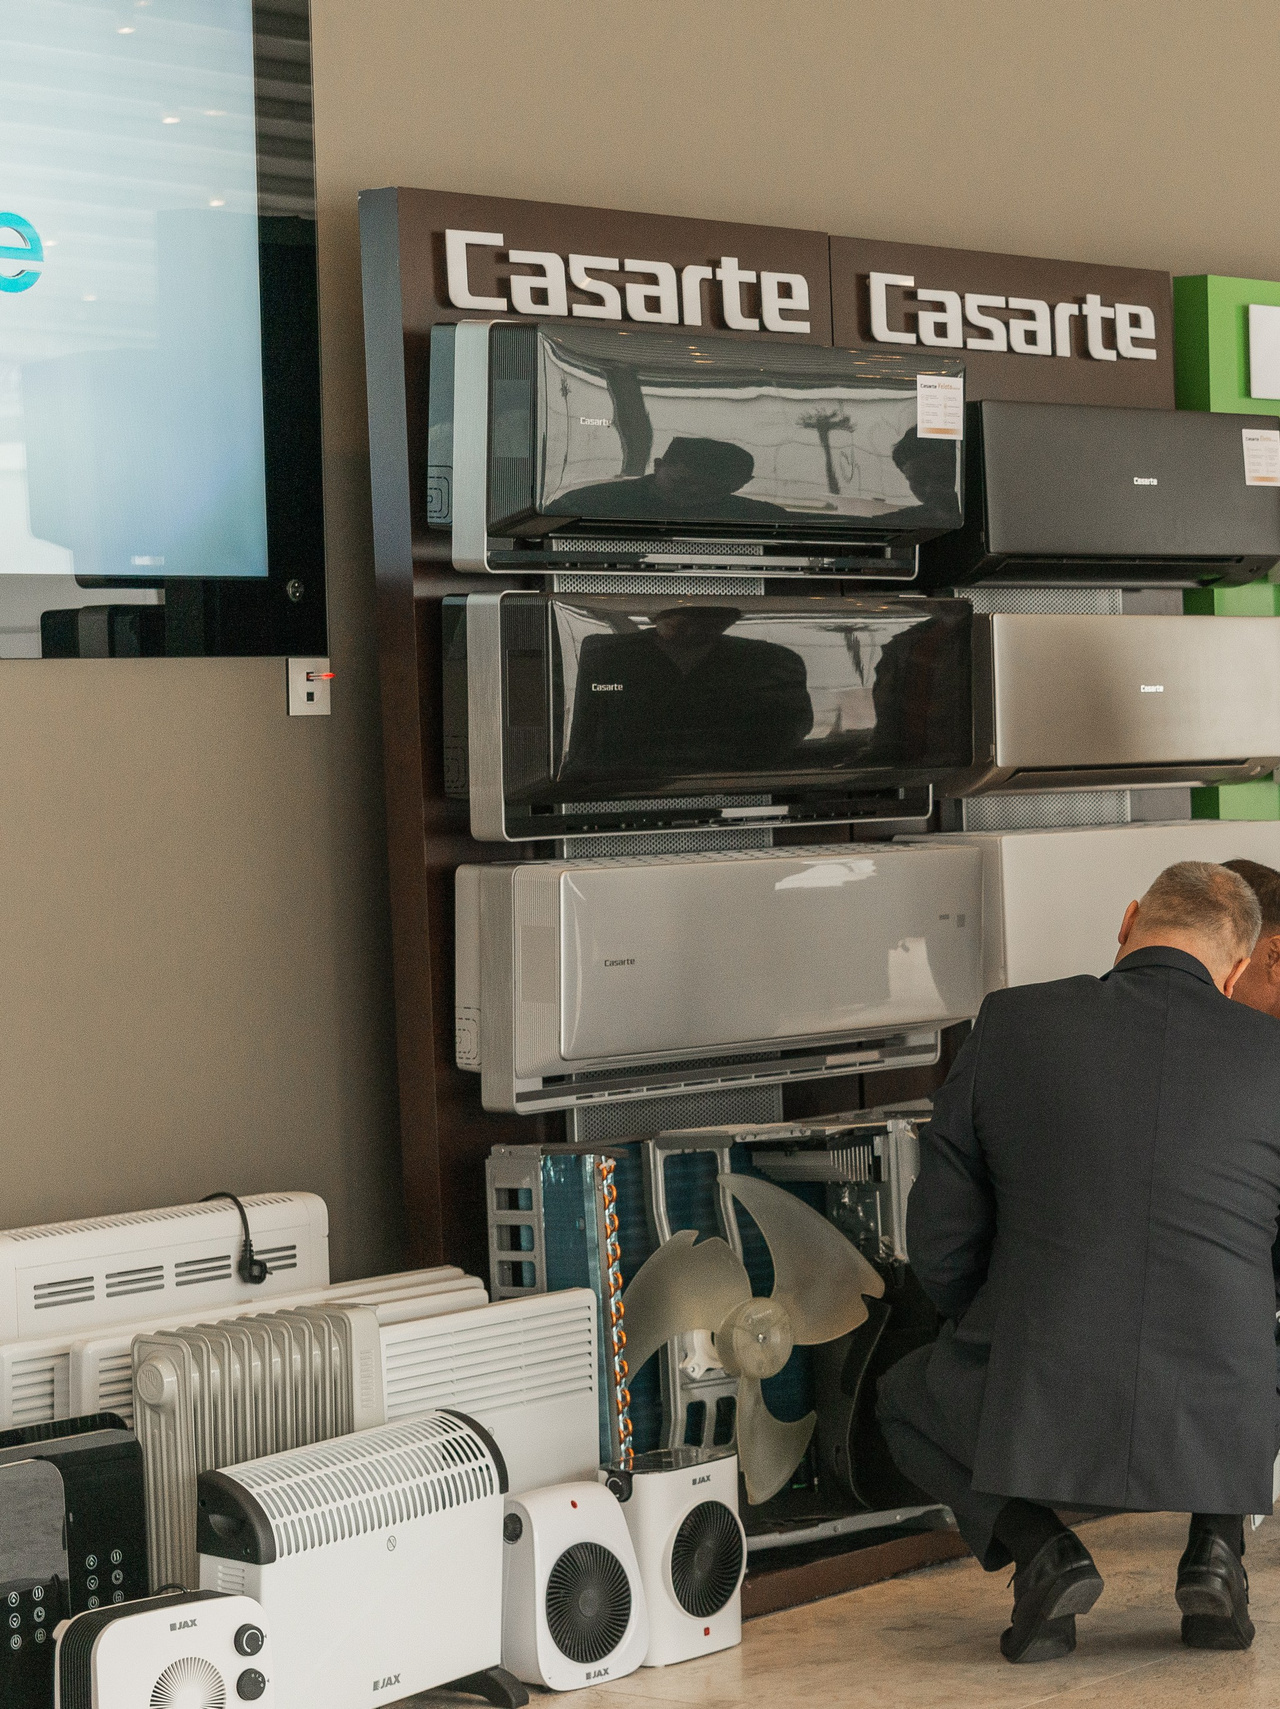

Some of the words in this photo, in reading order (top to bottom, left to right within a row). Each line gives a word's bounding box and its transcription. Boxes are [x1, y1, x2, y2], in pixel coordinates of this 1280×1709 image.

[445, 229, 811, 333] Casarte
[869, 271, 1157, 361] Casarte
[591, 683, 624, 692] Casarte
[604, 958, 636, 967] Casarte
